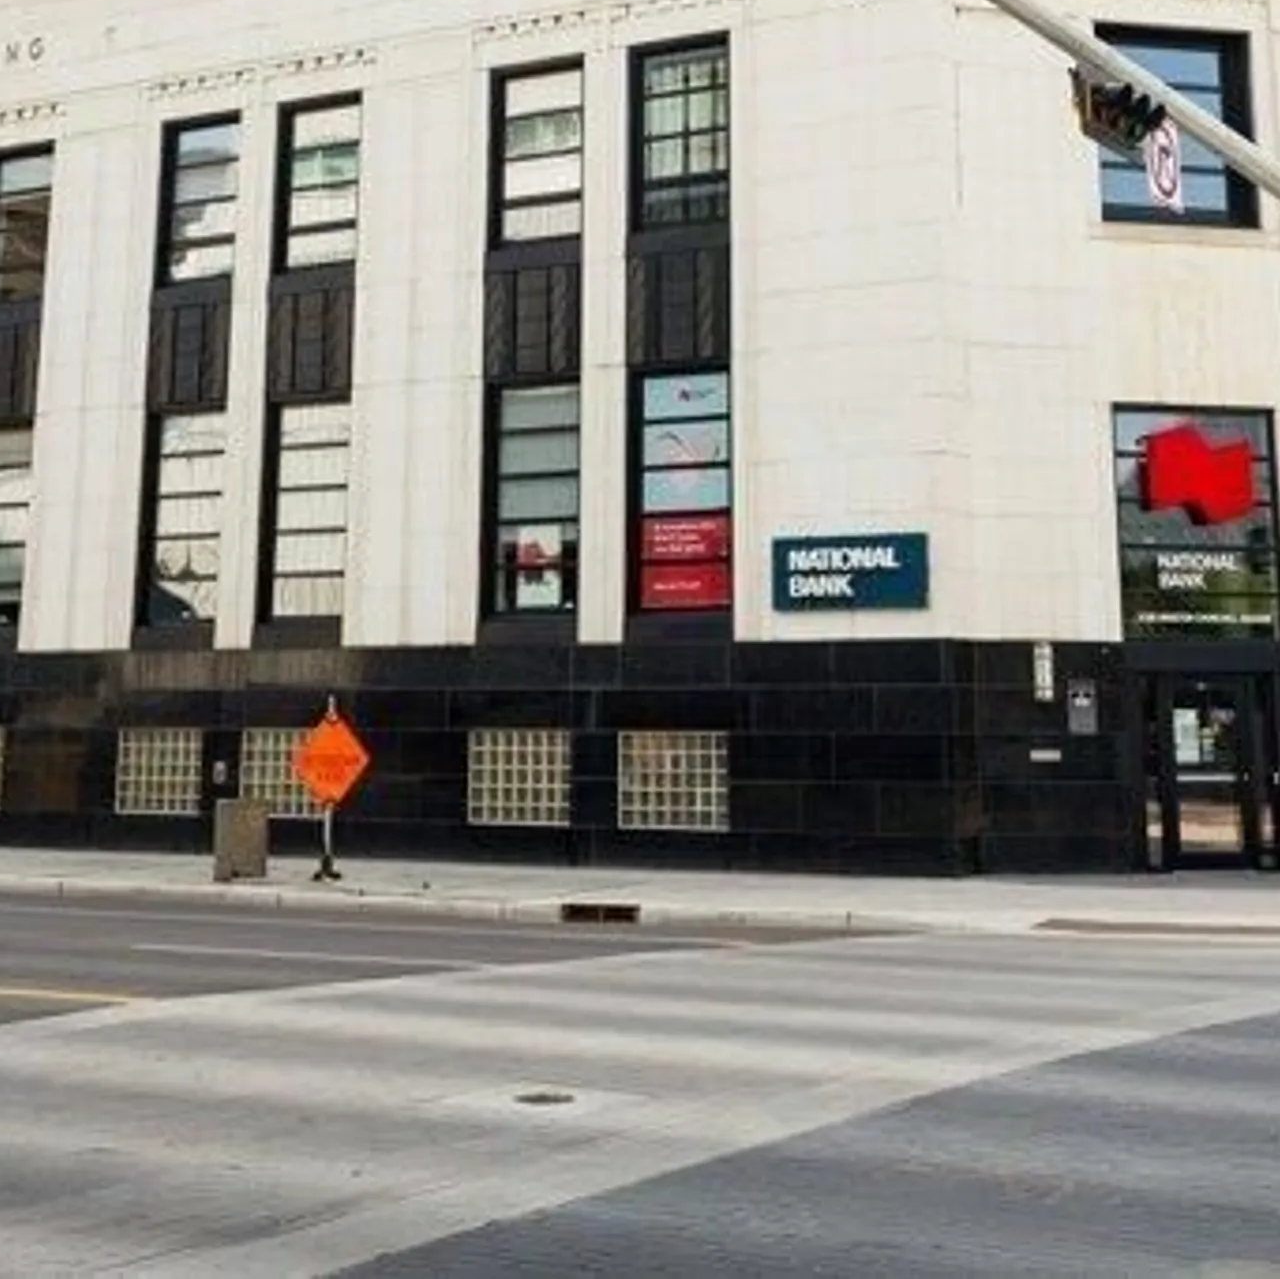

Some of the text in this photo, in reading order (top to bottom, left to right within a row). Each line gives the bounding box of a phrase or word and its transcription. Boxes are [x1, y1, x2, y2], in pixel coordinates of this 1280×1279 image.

[788, 545, 901, 571] NATIONAL
[1157, 552, 1238, 571] NATIONAL
[788, 573, 855, 599] BANK
[1157, 571, 1208, 591] BANK
